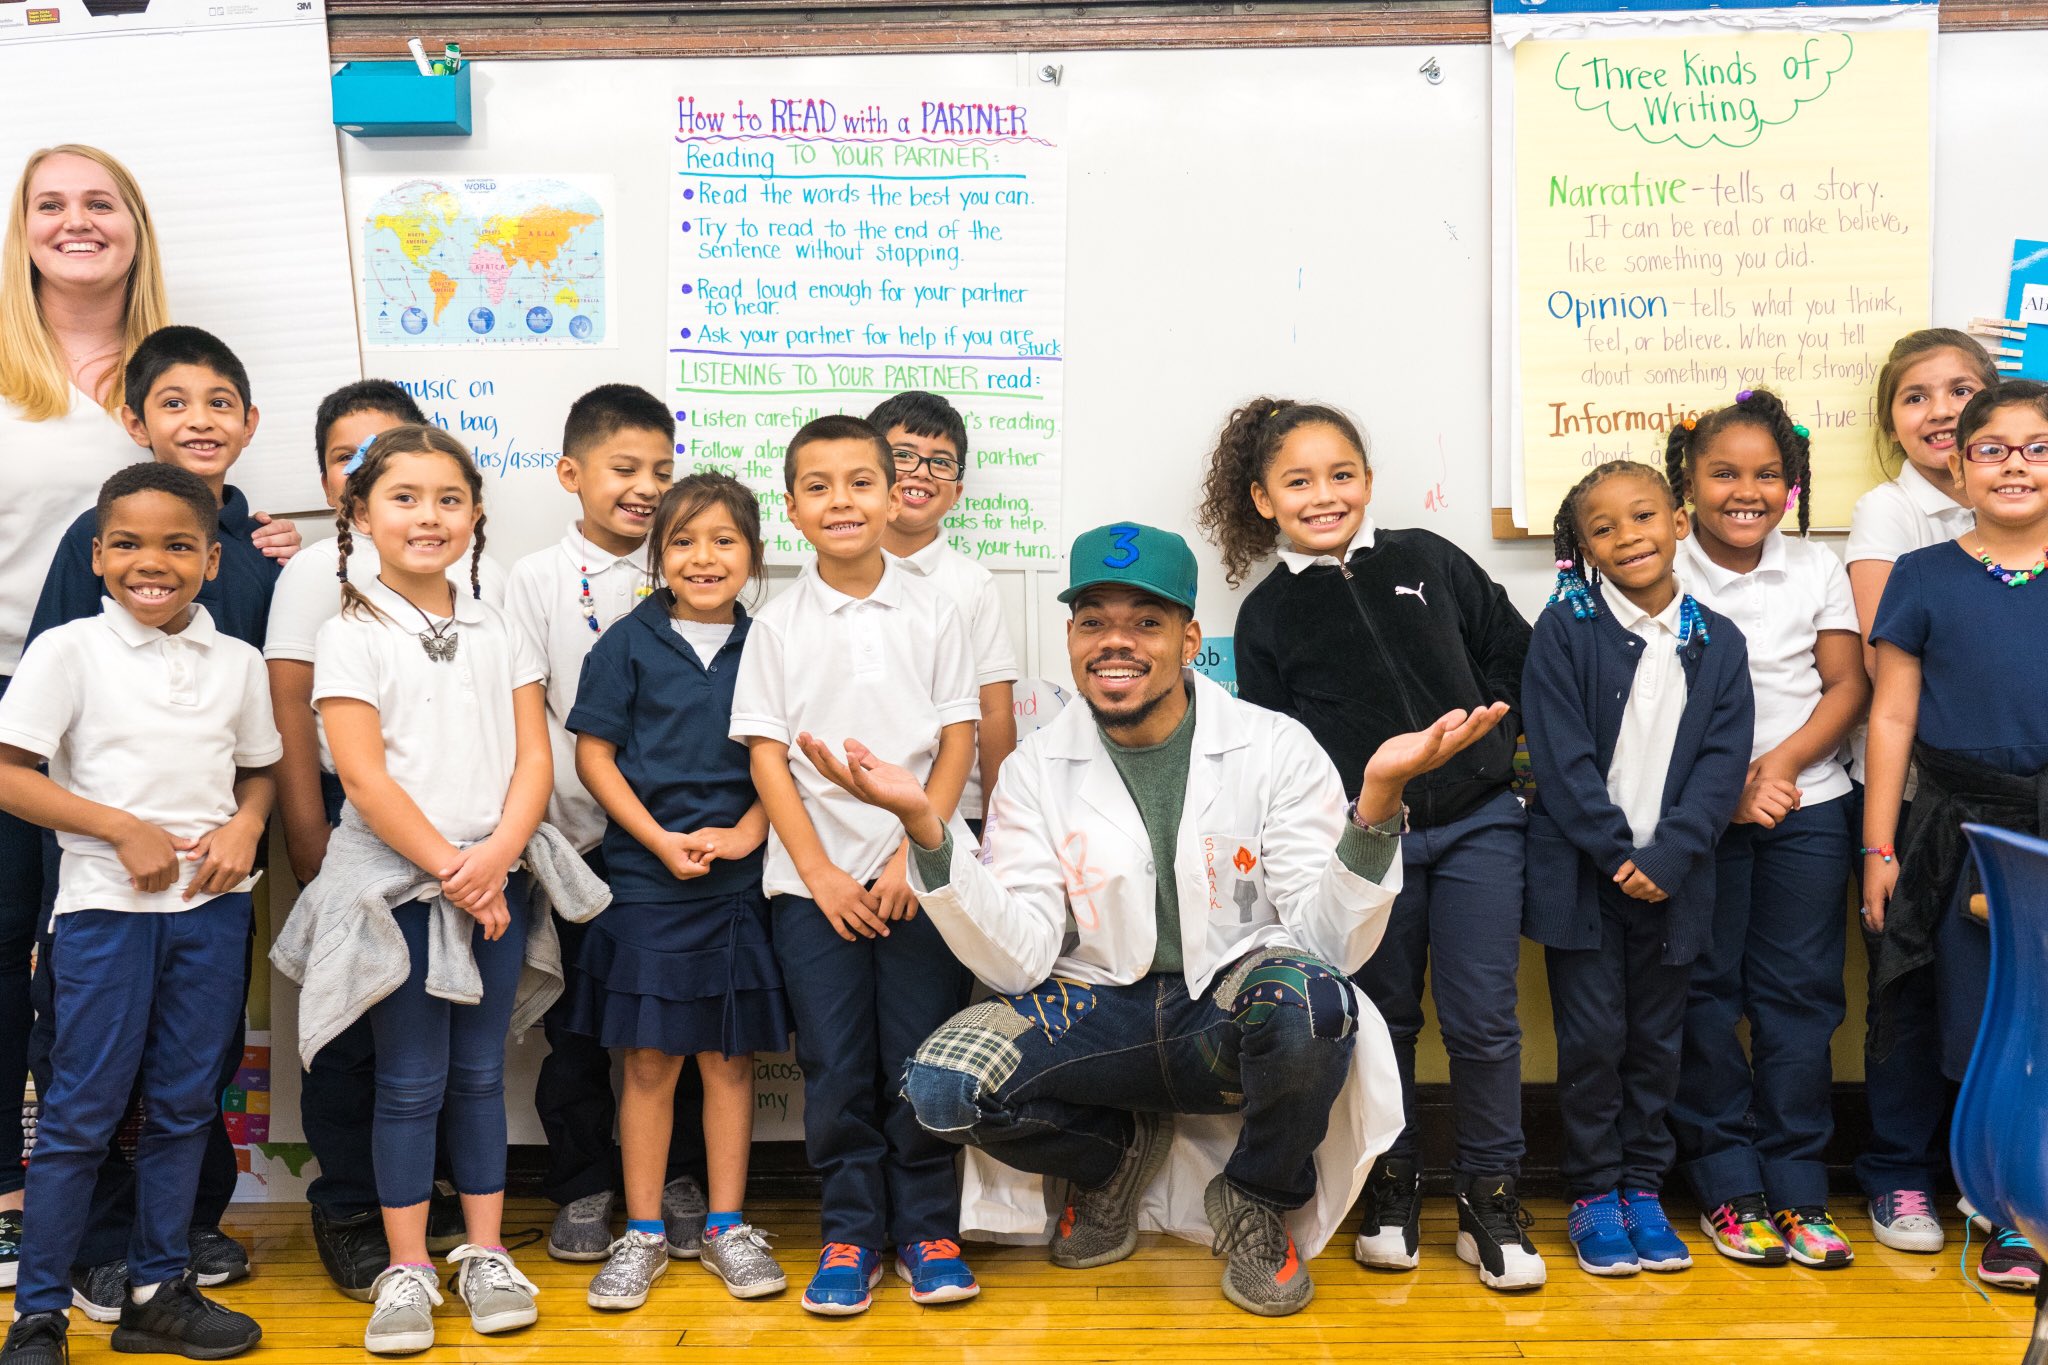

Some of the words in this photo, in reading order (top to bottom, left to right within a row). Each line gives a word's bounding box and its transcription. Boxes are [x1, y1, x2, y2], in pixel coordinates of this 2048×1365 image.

[297, 2, 311, 10] 3M
[1582, 57, 1668, 90] Three
[1684, 50, 1757, 86] Kinds
[1783, 38, 1820, 80] of
[677, 96, 725, 132] How
[733, 100, 762, 132] to
[771, 98, 836, 133] READ
[844, 106, 887, 133] with
[898, 117, 910, 134] a
[921, 101, 1028, 135] PARTNER
[1644, 91, 1759, 132] Writing
[687, 144, 775, 180] Reading
[786, 144, 816, 165] TO
[833, 146, 884, 167] YOUR
[894, 147, 999, 170] PARTNER:
[699, 182, 748, 205] Read
[760, 184, 793, 205] the
[803, 183, 860, 204] words
[868, 184, 901, 205] the
[910, 184, 950, 206] best
[960, 188, 989, 211] you
[995, 190, 1035, 206] can.
[1780, 180, 1795, 201] a
[1814, 167, 1884, 211] story.
[694, 217, 728, 243] Try
[737, 217, 759, 238] to
[768, 219, 814, 237] read
[824, 219, 846, 238] to
[854, 220, 888, 239] the
[894, 220, 928, 239] end
[938, 220, 960, 239] of
[968, 220, 1002, 241] the
[1583, 213, 1609, 239] It
[1622, 218, 1660, 239] can
[1671, 212, 1694, 237] be
[1704, 211, 1739, 236] real
[1752, 218, 1775, 234] or
[1783, 210, 1828, 234] make
[1839, 204, 1910, 234] believe,
[699, 241, 781, 260] sentence
[795, 241, 865, 260] without
[877, 243, 964, 270] stopping.
[1568, 241, 1608, 273] like
[1624, 244, 1724, 277] something
[1736, 249, 1767, 276] you
[1776, 243, 1815, 269] did.
[698, 278, 743, 300] Read
[757, 279, 797, 300] loud
[808, 280, 872, 306] enough
[878, 279, 905, 302] for
[914, 286, 957, 308] your
[962, 283, 1029, 307] partner
[704, 300, 728, 316] to
[735, 298, 779, 316] hear.
[1547, 290, 1668, 328] Opinion
[1752, 289, 1792, 317] what
[1806, 297, 1836, 325] you
[1846, 286, 1902, 317] think,
[697, 325, 732, 344] Ask
[741, 329, 779, 349] your
[786, 327, 855, 354] partner
[862, 324, 888, 345] for
[899, 325, 936, 346] help
[944, 326, 959, 345] if
[962, 331, 993, 352] you
[1000, 329, 1035, 345] are
[1018, 339, 1061, 357] stuck
[1584, 325, 1629, 355] feel,
[1634, 333, 1655, 351] or
[1663, 325, 1731, 350] believe.
[1739, 322, 1787, 349] When
[1797, 330, 1829, 358] you
[1840, 323, 1865, 346] tell
[680, 360, 787, 386] LISTENING
[793, 364, 818, 386] TO
[827, 363, 873, 388] YOUR
[884, 365, 979, 390] PARTNER
[1581, 360, 1632, 386] about
[1644, 357, 1728, 384] something
[1737, 364, 1766, 390] you
[1774, 353, 1803, 382] feel
[1812, 352, 1878, 383] strongly
[395, 379, 459, 401] music
[469, 379, 495, 397] on
[460, 410, 498, 439] bag
[691, 408, 747, 428] Listen
[1809, 400, 1857, 428] true
[690, 438, 744, 459] Follow
[977, 447, 1046, 469] partner
[742, 460, 773, 478] the
[1424, 482, 1449, 512] at
[943, 513, 978, 529] asks
[982, 513, 1003, 529] for
[976, 539, 1011, 560] your
[1103, 526, 1140, 569] 3
[758, 1092, 788, 1121] my
